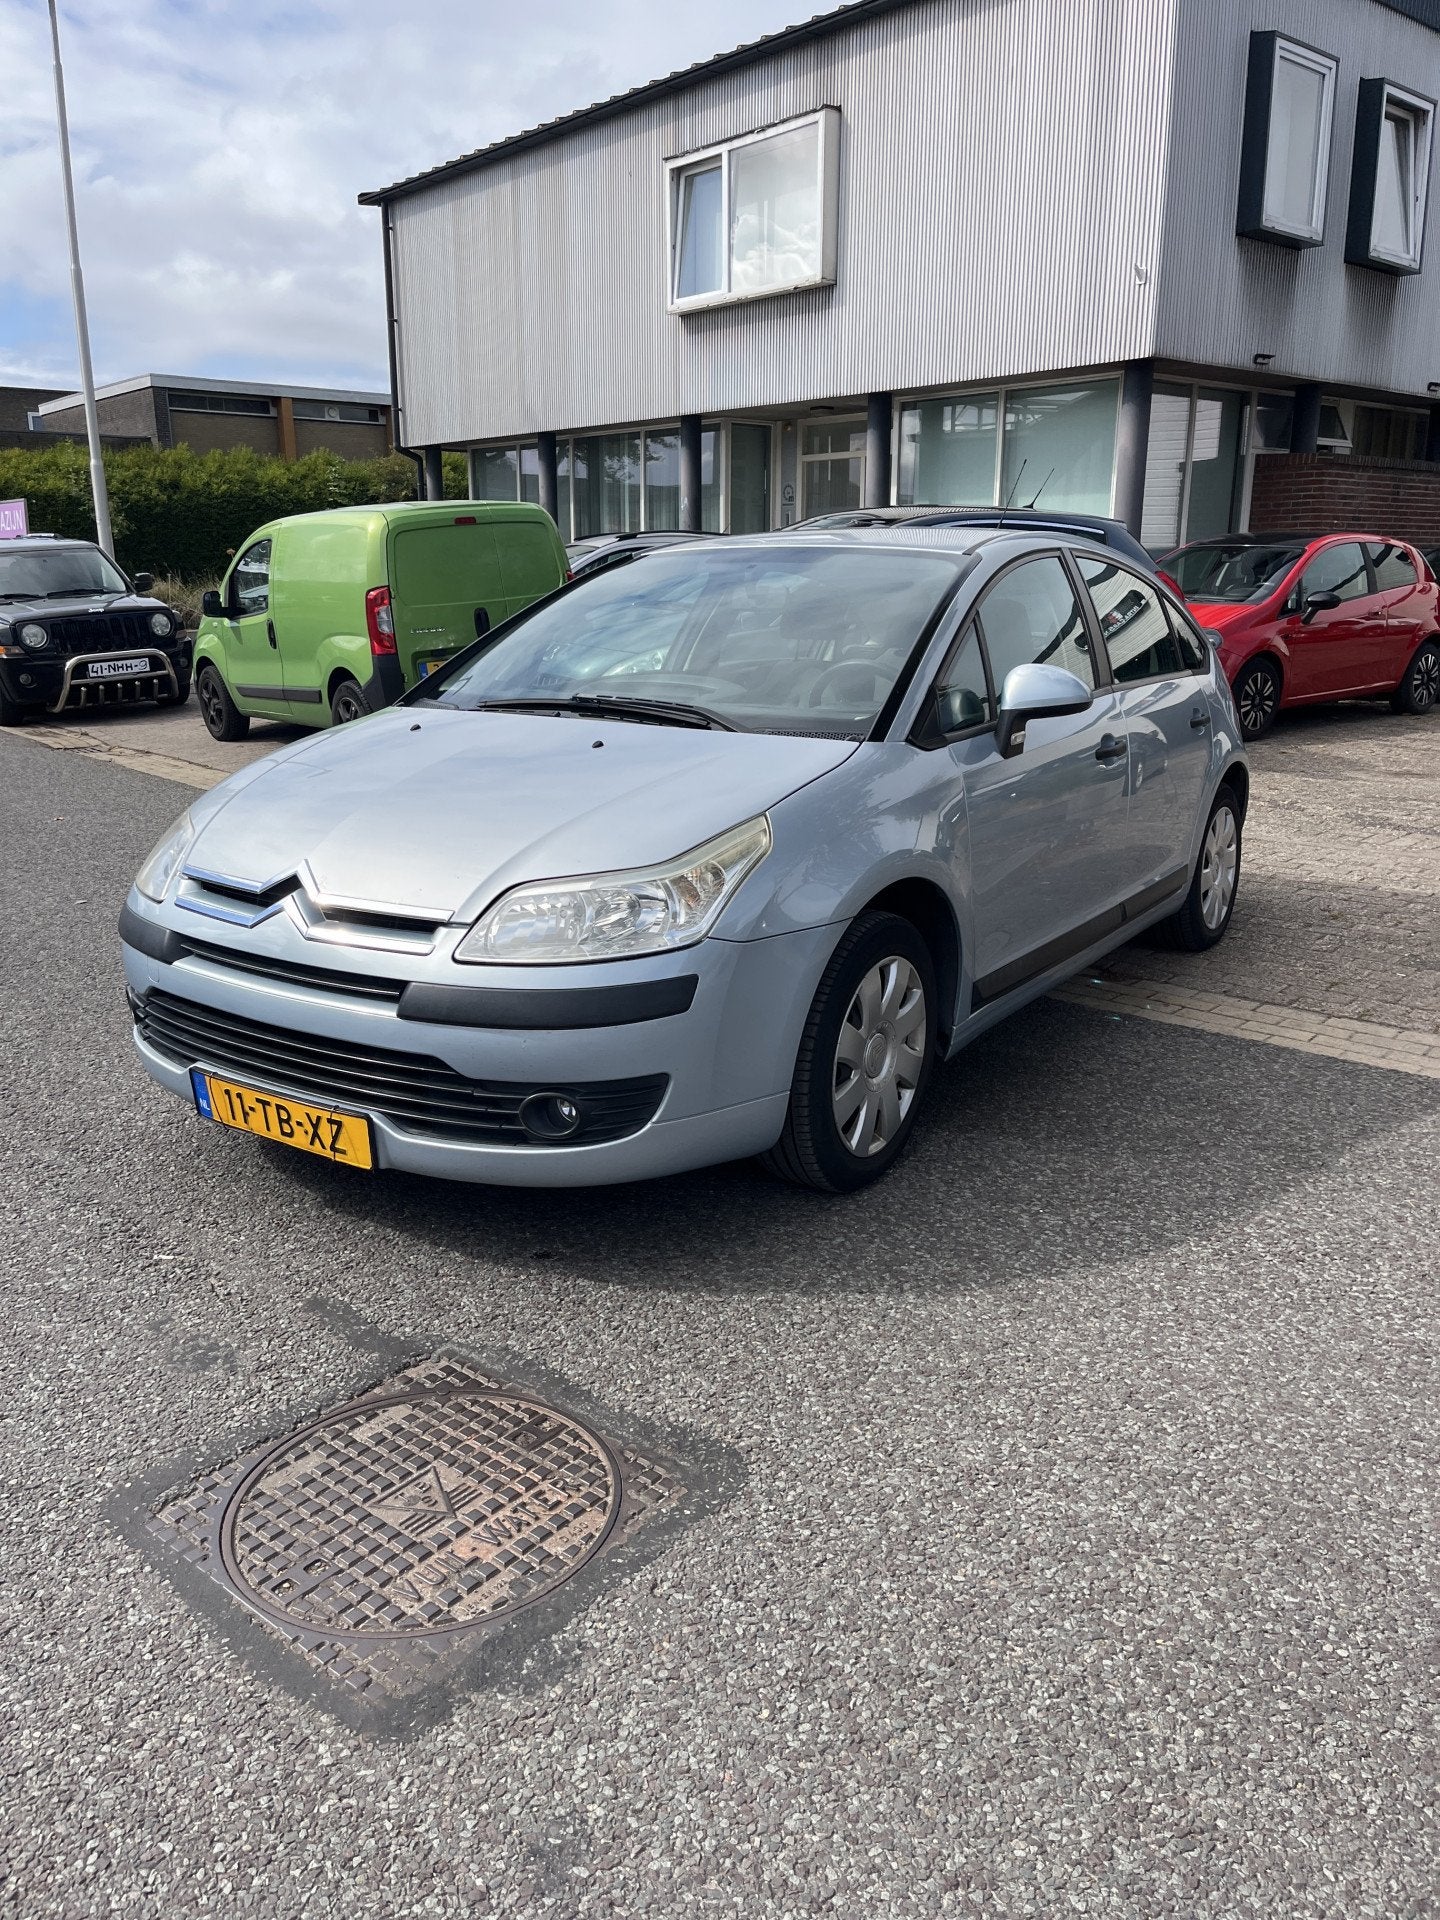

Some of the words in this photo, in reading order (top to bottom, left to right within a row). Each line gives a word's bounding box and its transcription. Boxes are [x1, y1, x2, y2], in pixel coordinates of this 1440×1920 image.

[91, 660, 148, 676] 41-NHH-9
[224, 1088, 347, 1155] 11-TB-XZ
[392, 1552, 480, 1602] VUIL
[471, 1477, 582, 1547] WATER
